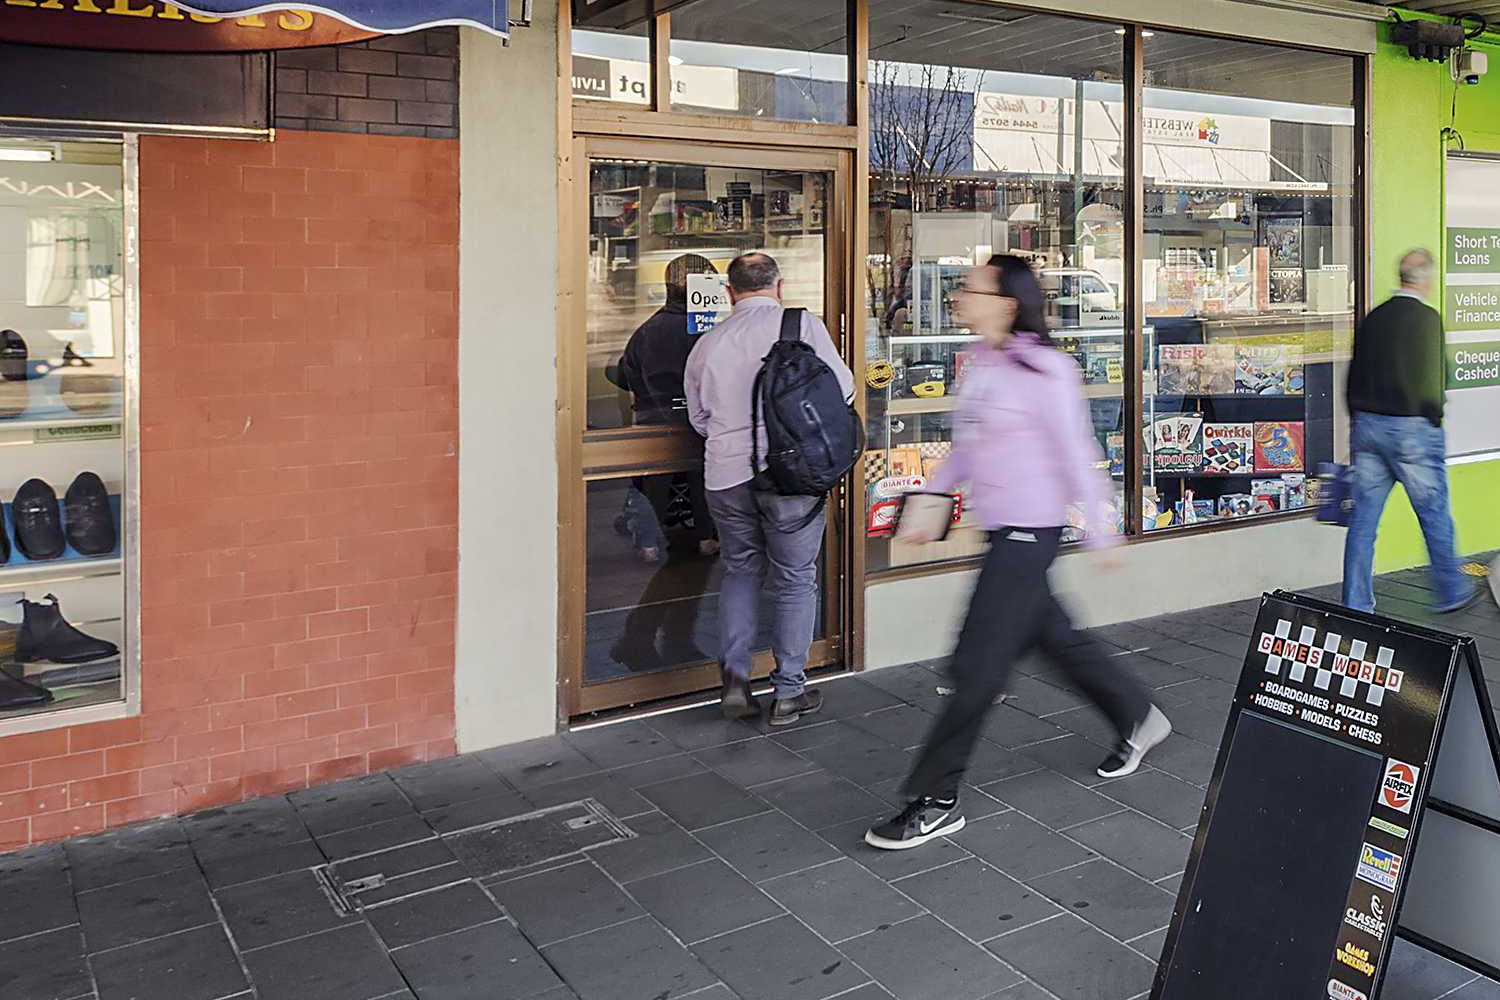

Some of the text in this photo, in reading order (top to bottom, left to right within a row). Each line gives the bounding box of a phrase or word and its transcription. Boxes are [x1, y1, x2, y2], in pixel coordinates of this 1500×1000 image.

[1455, 234, 1487, 249] Short
[1455, 252, 1490, 265] Loans
[690, 291, 728, 308] Open
[1455, 293, 1498, 306] Vehicle
[1455, 309, 1500, 323] Finance
[1161, 346, 1204, 360] Risk
[1250, 346, 1279, 358] LIFE
[1455, 366, 1499, 381] Cashed
[1204, 425, 1252, 439] Qwirkle
[1272, 427, 1288, 450] 5
[1261, 636, 1400, 688] GAMES WORLD
[1264, 681, 1379, 727] BOARDGAMES PUZZLES
[1254, 692, 1383, 746] HOBBIES MODELS CHESS
[1384, 776, 1414, 797] AIRFIX
[1362, 847, 1391, 873] Revell
[1359, 865, 1395, 886] MONOGRAM
[1346, 907, 1386, 934] CLASSIC
[1345, 941, 1370, 962] GAMES
[1336, 948, 1376, 977] WORKSHOP
[1332, 982, 1355, 1000] BIANTE
